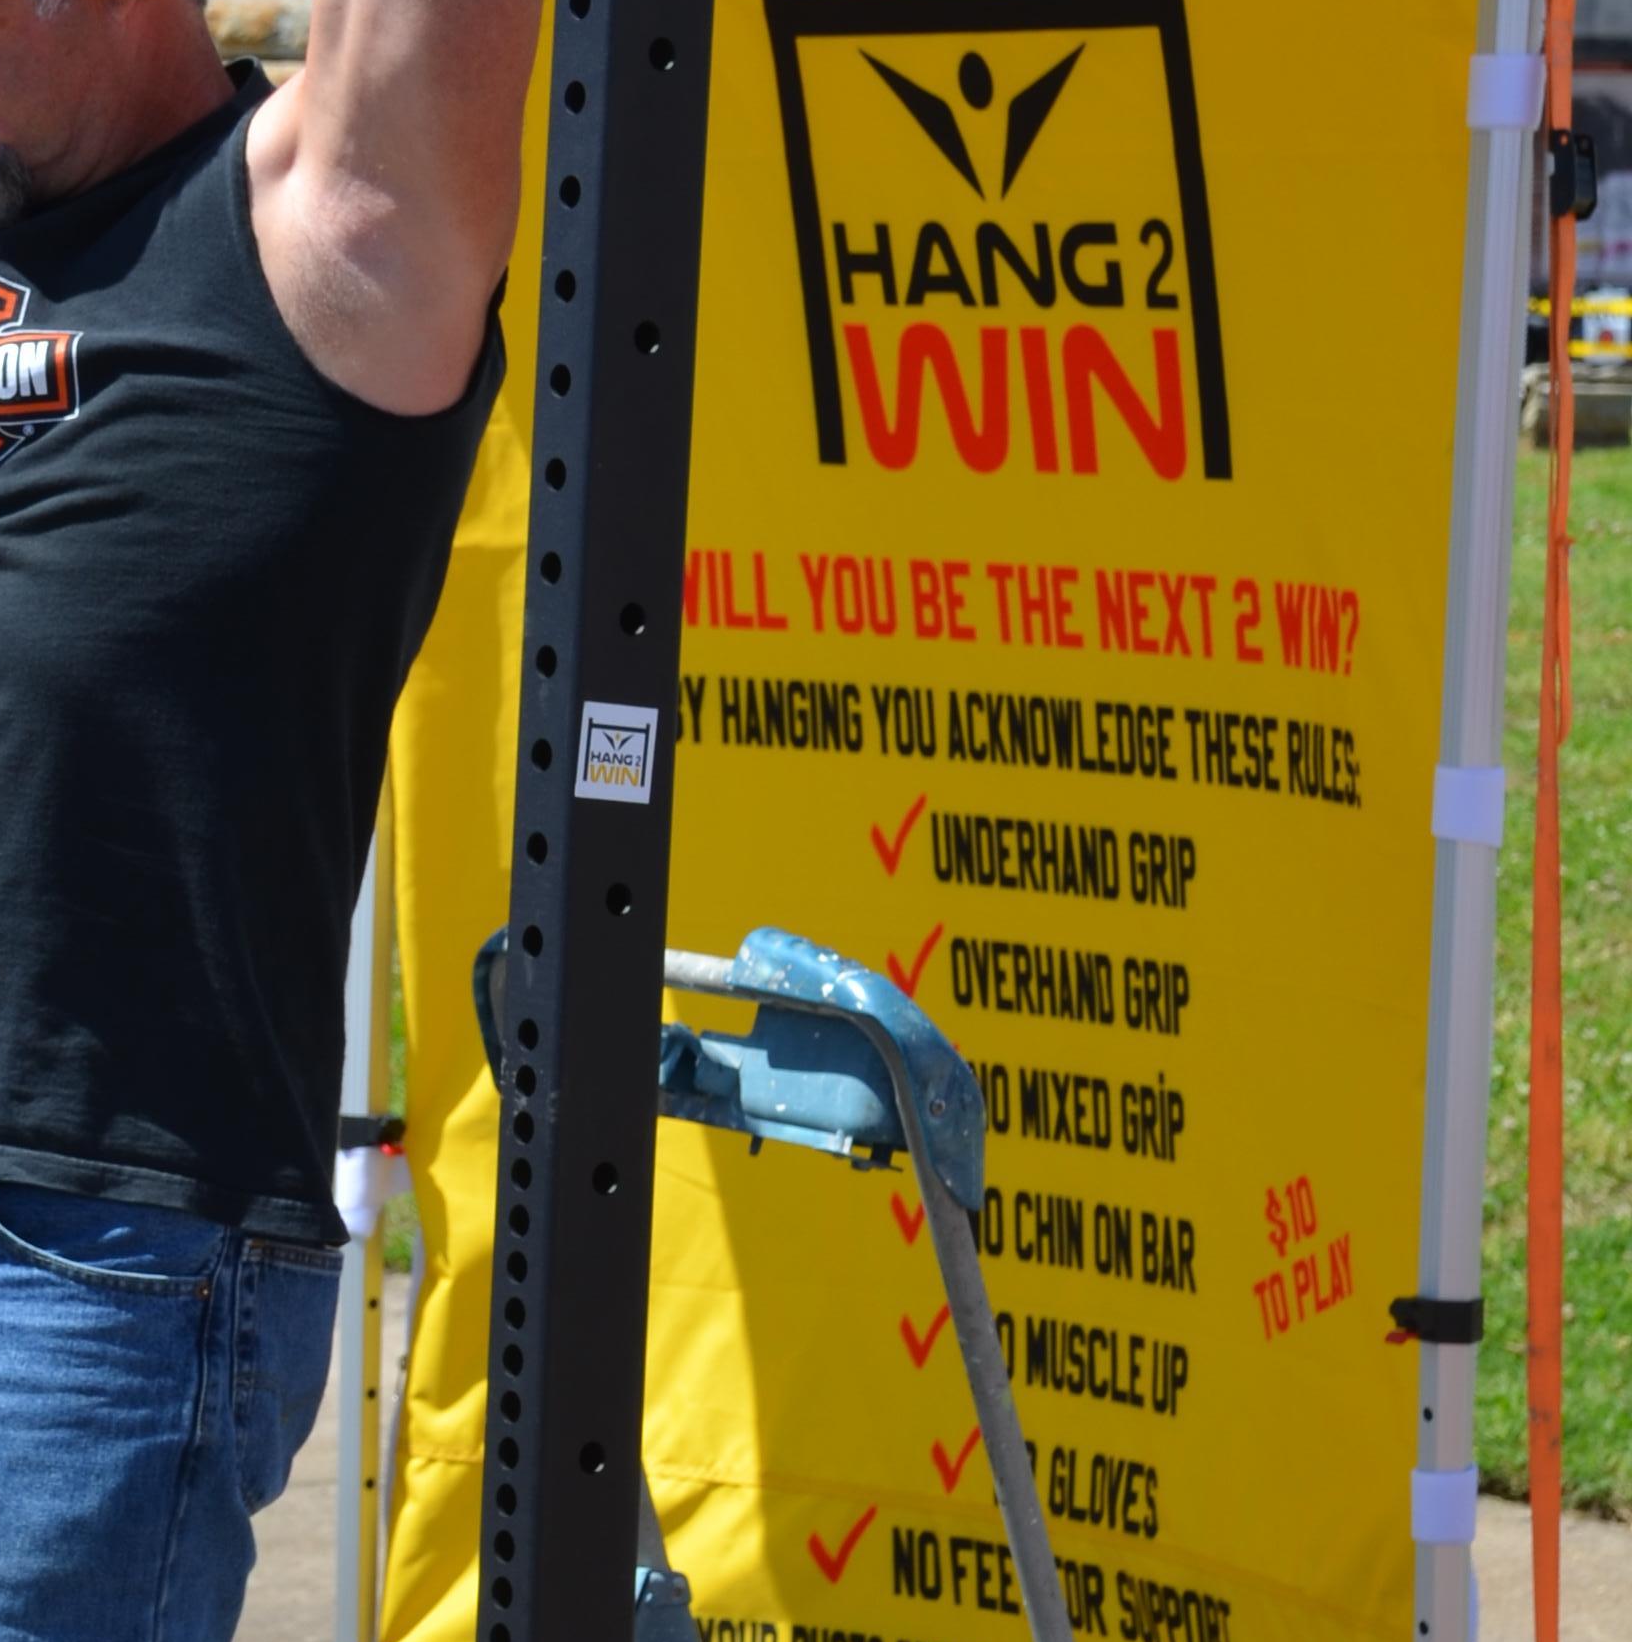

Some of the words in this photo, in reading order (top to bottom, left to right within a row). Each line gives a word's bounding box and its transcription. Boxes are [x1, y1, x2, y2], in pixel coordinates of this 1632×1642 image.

[832, 220, 1125, 310] HANG
[842, 321, 1189, 483] WIN
[797, 552, 898, 638] YOU
[909, 557, 978, 643] BE
[986, 562, 1085, 650] THE
[1094, 566, 1217, 660] NEXT
[1232, 575, 1265, 665] 2
[1273, 579, 1361, 677] WIN?
[589, 763, 641, 787] WIN
[590, 750, 633, 767] HANG
[719, 675, 864, 754] HANGING
[871, 683, 937, 760] YOU
[948, 688, 1179, 781] ACKNOWLEDGE
[1184, 707, 1281, 793] THESE
[930, 811, 1121, 901] UNDERHAND
[1128, 830, 1197, 911] GRIP
[950, 936, 1116, 1027] OVERHAND
[1124, 955, 1191, 1037] GRIP
[1019, 1066, 1112, 1150] MIXED
[1014, 1190, 1084, 1272] CHIN
[1093, 1202, 1133, 1281] ON
[1140, 1211, 1197, 1295] BAR
[1264, 1175, 1318, 1259] $10
[1253, 1271, 1291, 1344] TO
[1292, 1231, 1354, 1323] PLAY
[1025, 1314, 1145, 1409] MUSCLE
[1152, 1338, 1189, 1418] UP
[1048, 1444, 1159, 1541] GLOVES
[892, 1525, 944, 1601] NO
[949, 1536, 1021, 1617] FEE
